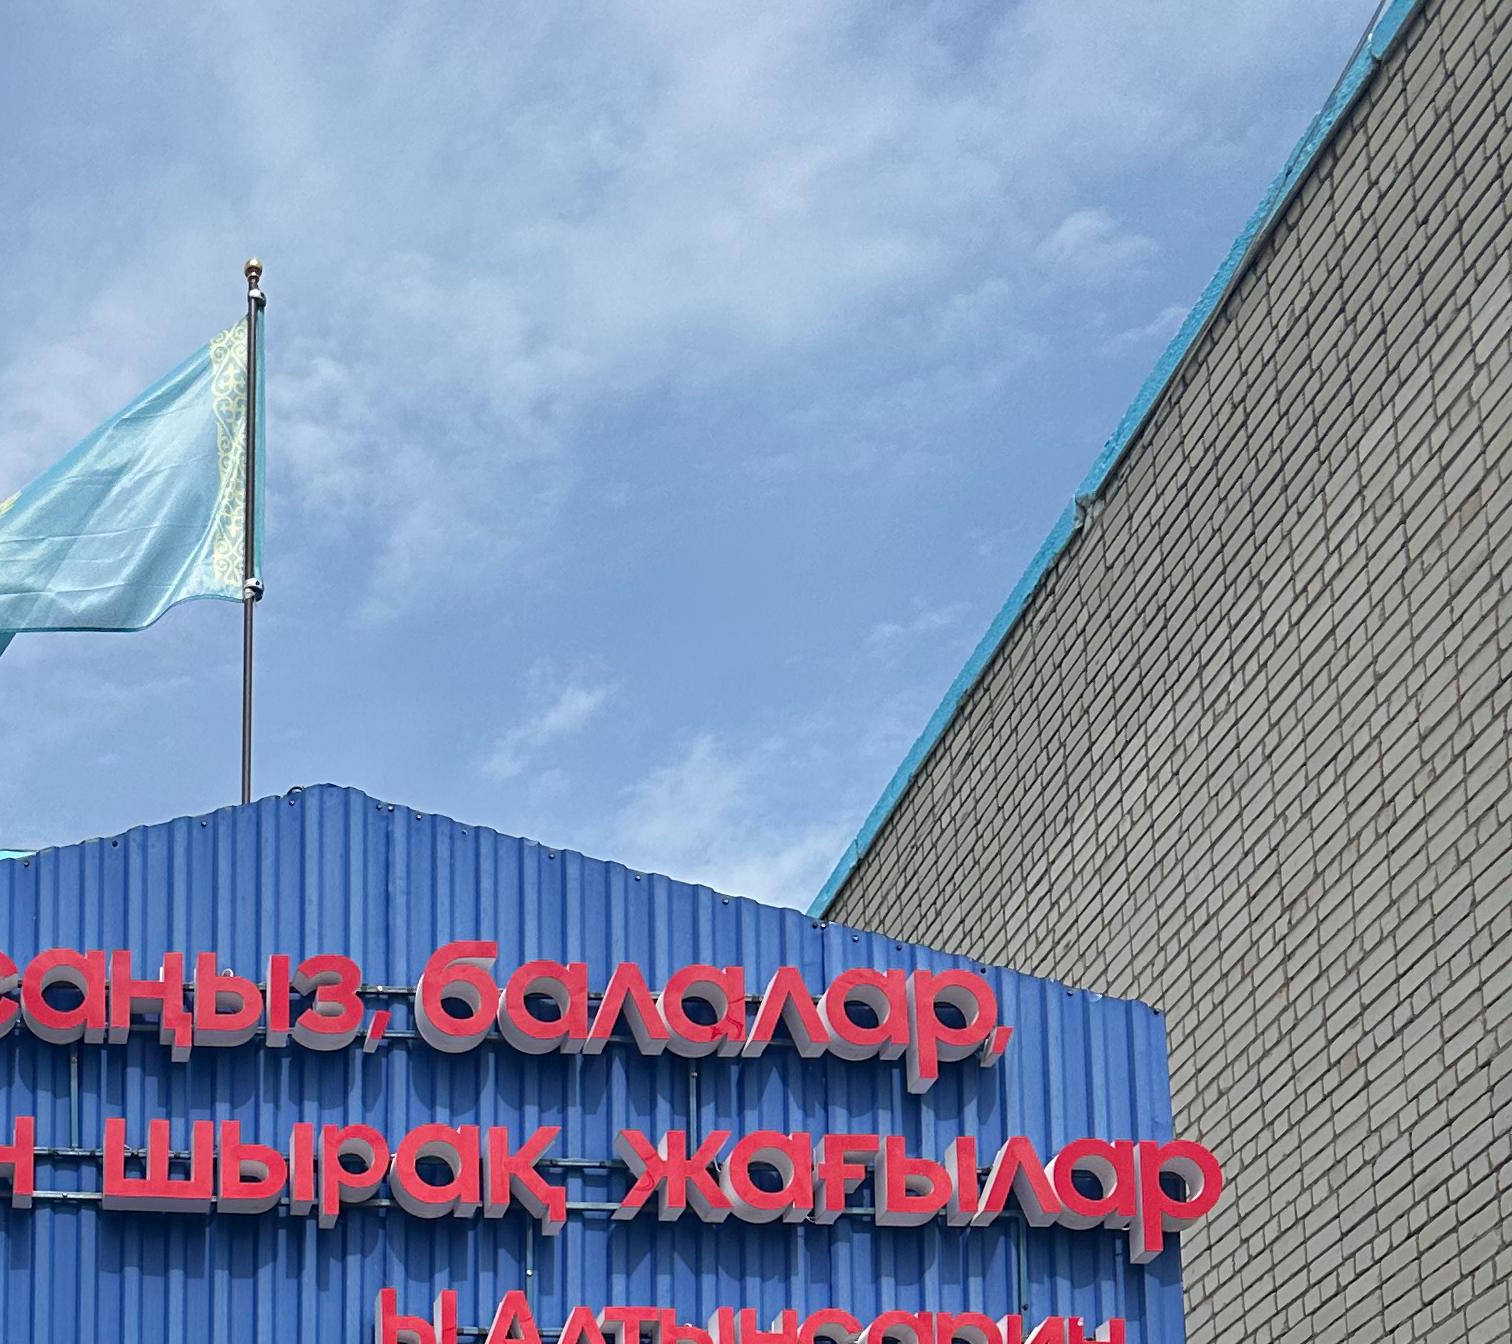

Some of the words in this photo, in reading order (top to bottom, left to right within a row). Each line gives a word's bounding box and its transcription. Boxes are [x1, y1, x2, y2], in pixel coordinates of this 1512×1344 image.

[419, 940, 1013, 1082] балалар,
[103, 1117, 567, 1225] шырақ
[620, 1129, 1224, 1256] жағылар
